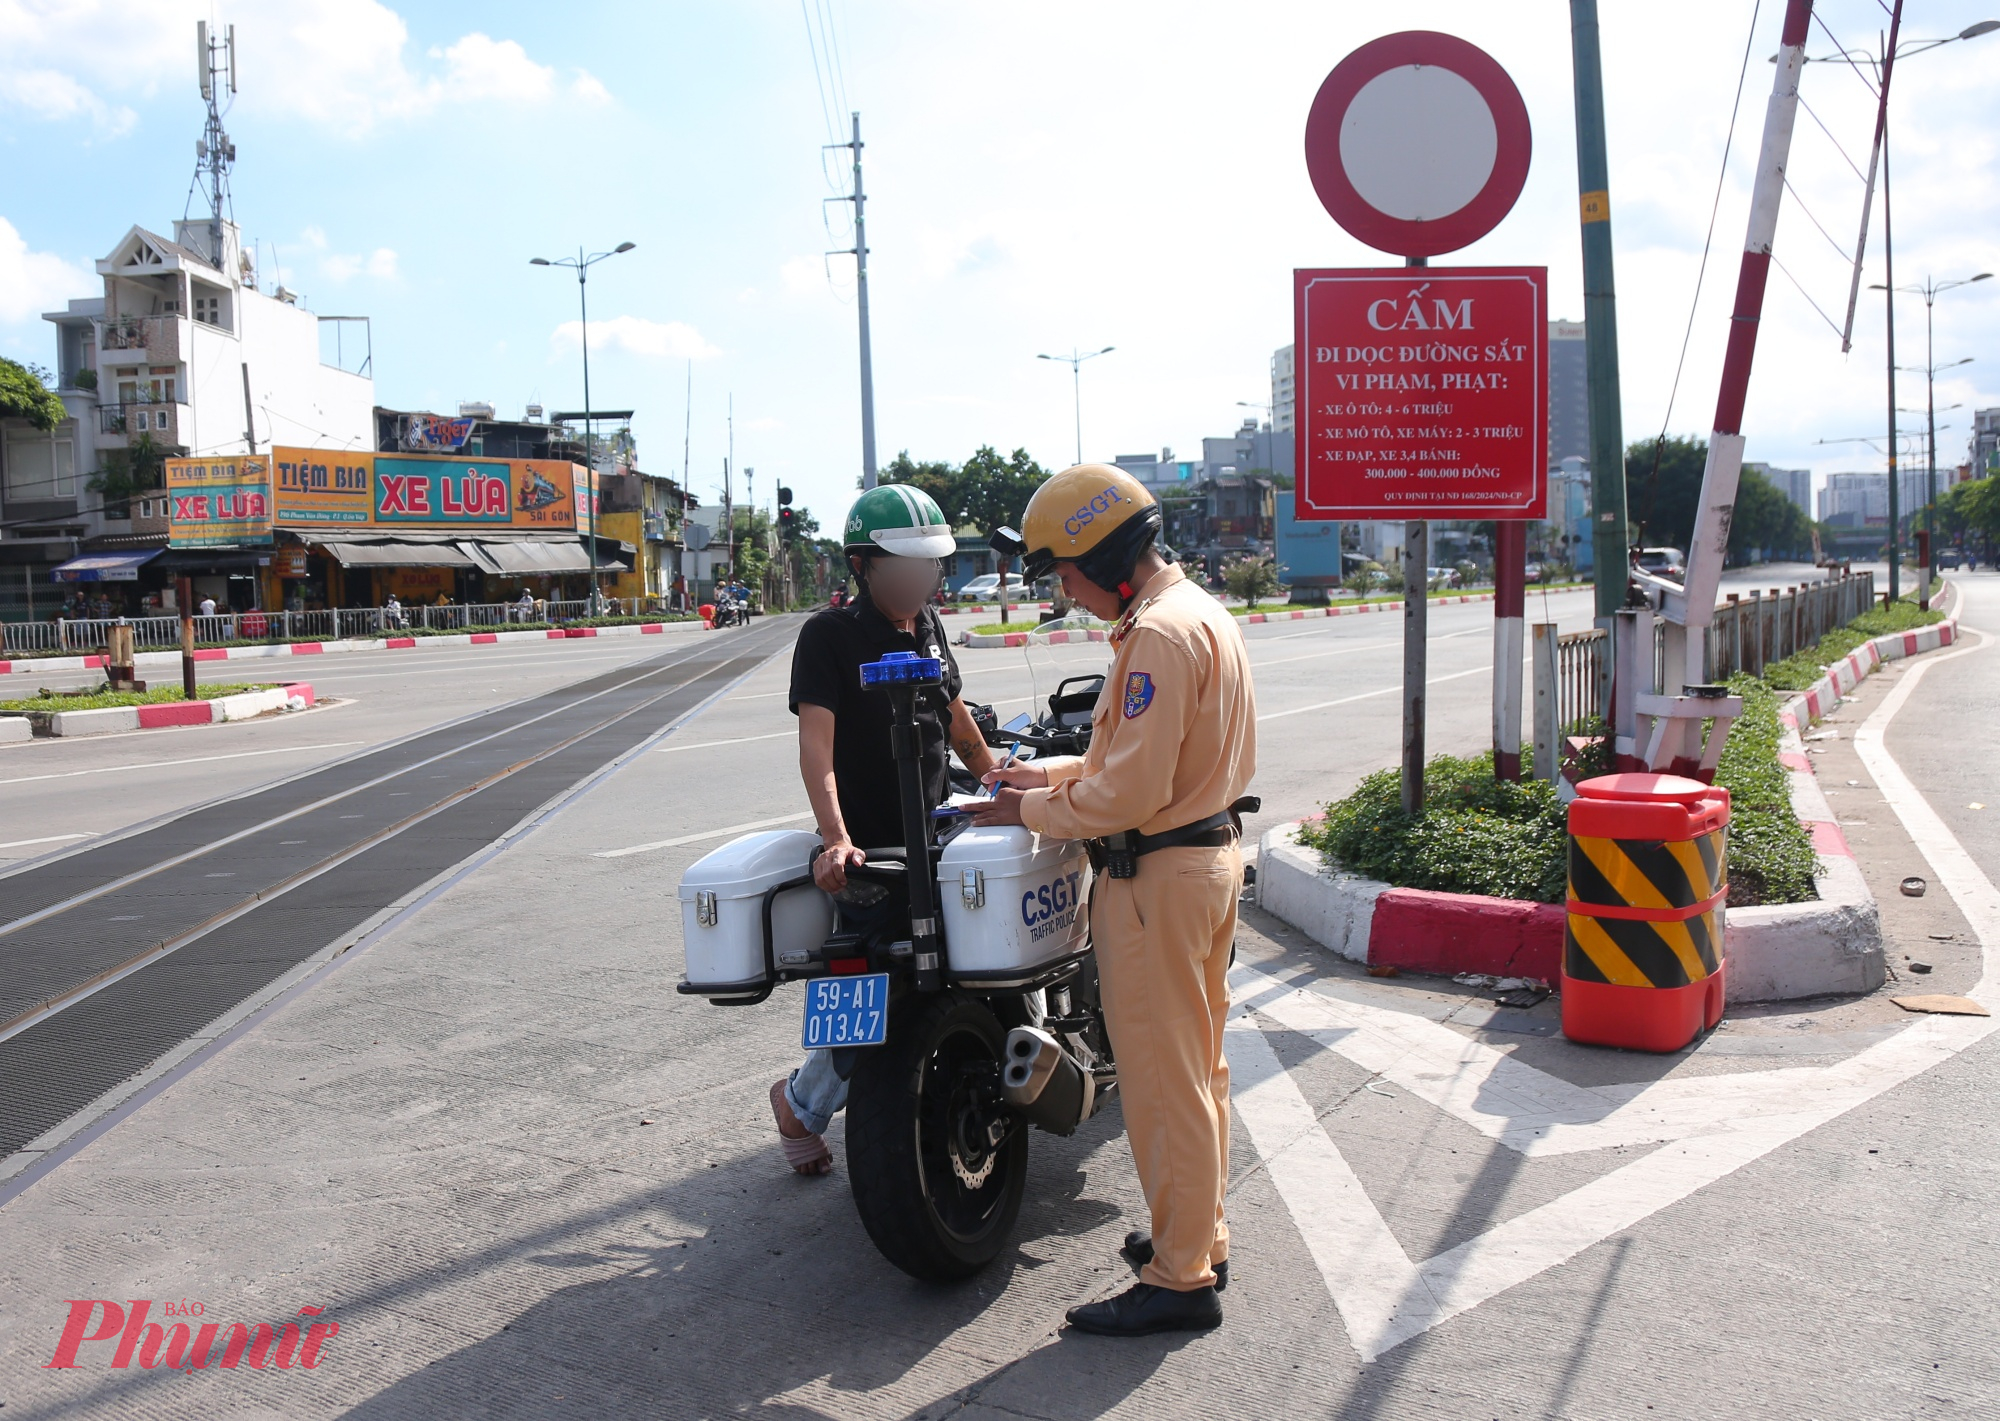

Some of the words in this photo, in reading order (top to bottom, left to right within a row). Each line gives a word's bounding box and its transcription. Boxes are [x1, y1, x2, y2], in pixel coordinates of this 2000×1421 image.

[1367, 282, 1475, 331] CẤM
[1316, 346, 1340, 363] ĐI
[1345, 346, 1394, 367] DỌC
[1398, 341, 1480, 362] ĐƯỜNG
[1484, 337, 1527, 362] SẮT
[1336, 373, 1359, 390] VI
[1364, 373, 1436, 394] PHẠM,
[1441, 373, 1508, 394] PHẠT:
[1325, 404, 1344, 415] XE
[1346, 401, 1357, 415] Ô
[1359, 401, 1382, 415] TÔ:
[1385, 404, 1393, 415] 4
[1402, 404, 1410, 415] 6
[1412, 401, 1453, 417] TRIỆU
[427, 416, 469, 445] Tiger
[1325, 428, 1344, 439] XE
[1346, 425, 1369, 439] MÔ
[1371, 425, 1394, 440] TÔ,
[1396, 428, 1415, 438] XE
[1418, 424, 1453, 438] MÁY:
[1455, 427, 1463, 438] 2
[1472, 427, 1480, 438] 3
[1482, 424, 1523, 440] TRIỆU
[1325, 450, 1344, 461] XE
[1346, 450, 1376, 464] ĐẠP,
[1379, 450, 1397, 461] XE
[1400, 450, 1417, 462] 3,4
[1419, 447, 1461, 461] BÁNH:
[1364, 468, 1407, 479] 300.000
[1417, 468, 1459, 479] 400.000
[1462, 463, 1501, 478] ĐỒNG
[170, 464, 206, 479] TIỆM
[211, 465, 236, 477] BIA
[278, 458, 327, 493] TIỆM
[335, 465, 366, 489] BIA
[174, 495, 210, 521] XE
[216, 487, 265, 520] LỬA
[379, 474, 431, 514] XE
[441, 468, 508, 516] LỬA
[1384, 492, 1403, 501] QUY
[1405, 492, 1428, 501] ĐỊNH
[1429, 492, 1445, 501] TẠI
[1064, 485, 1122, 536] CSGT
[1021, 871, 1079, 927] C.S.G.T
[1030, 919, 1055, 943] TRAFFIC
[1056, 909, 1076, 932] POLICE
[816, 979, 875, 1011] 59-A1
[808, 1010, 880, 1044] 013.47
